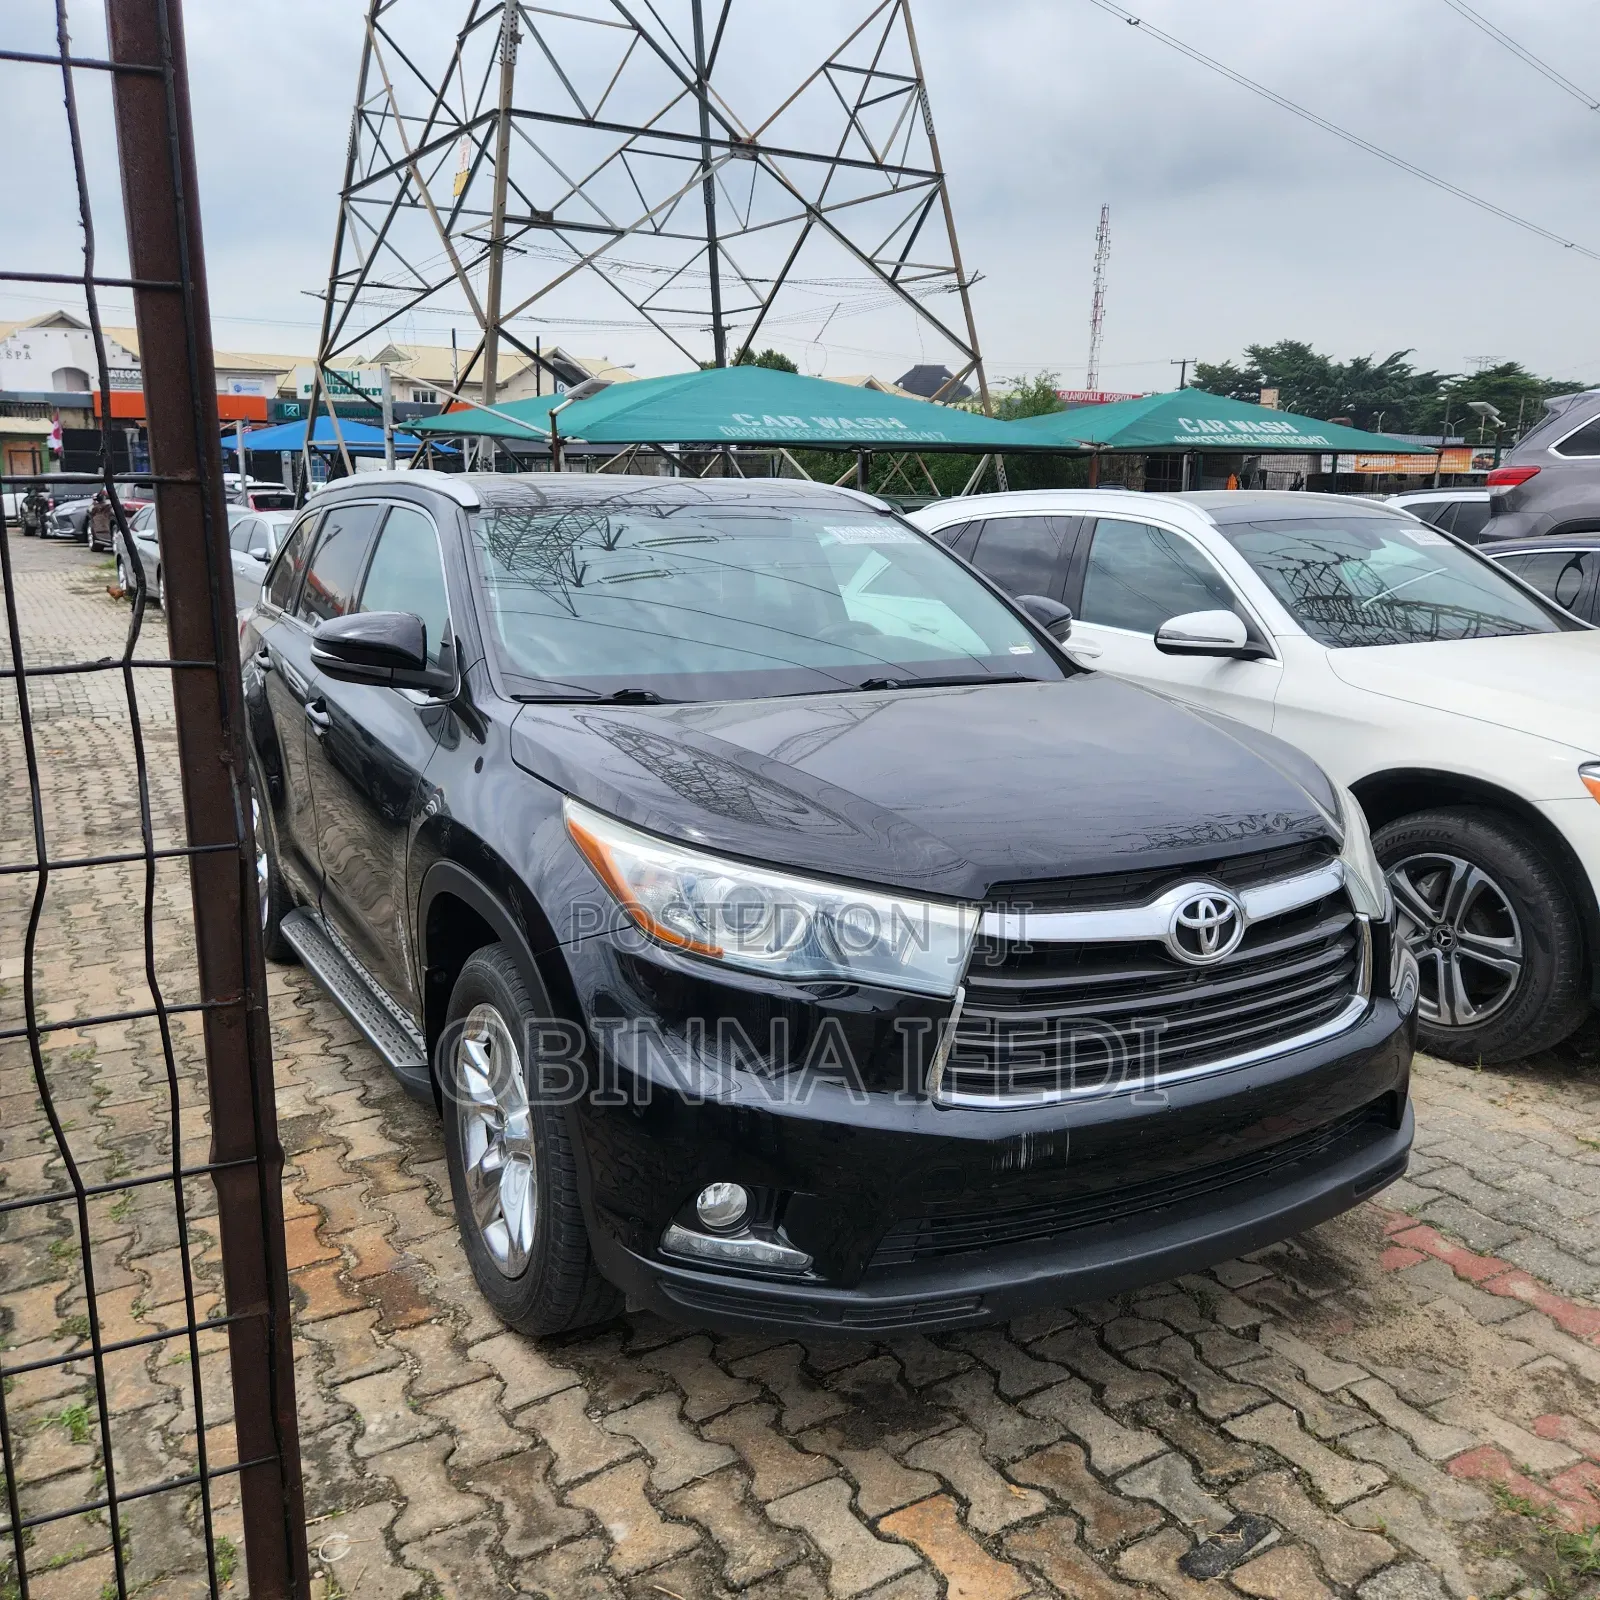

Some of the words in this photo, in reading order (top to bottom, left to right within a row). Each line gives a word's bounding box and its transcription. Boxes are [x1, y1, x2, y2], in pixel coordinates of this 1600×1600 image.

[303, 384, 382, 396] SERMRKET
[1059, 391, 1101, 401] GRANDVILLE
[732, 413, 810, 428] CAR
[810, 416, 908, 429] WASH
[1178, 417, 1233, 433] CAR
[1229, 419, 1299, 434] WASH
[1375, 828, 1457, 852] CORPION
